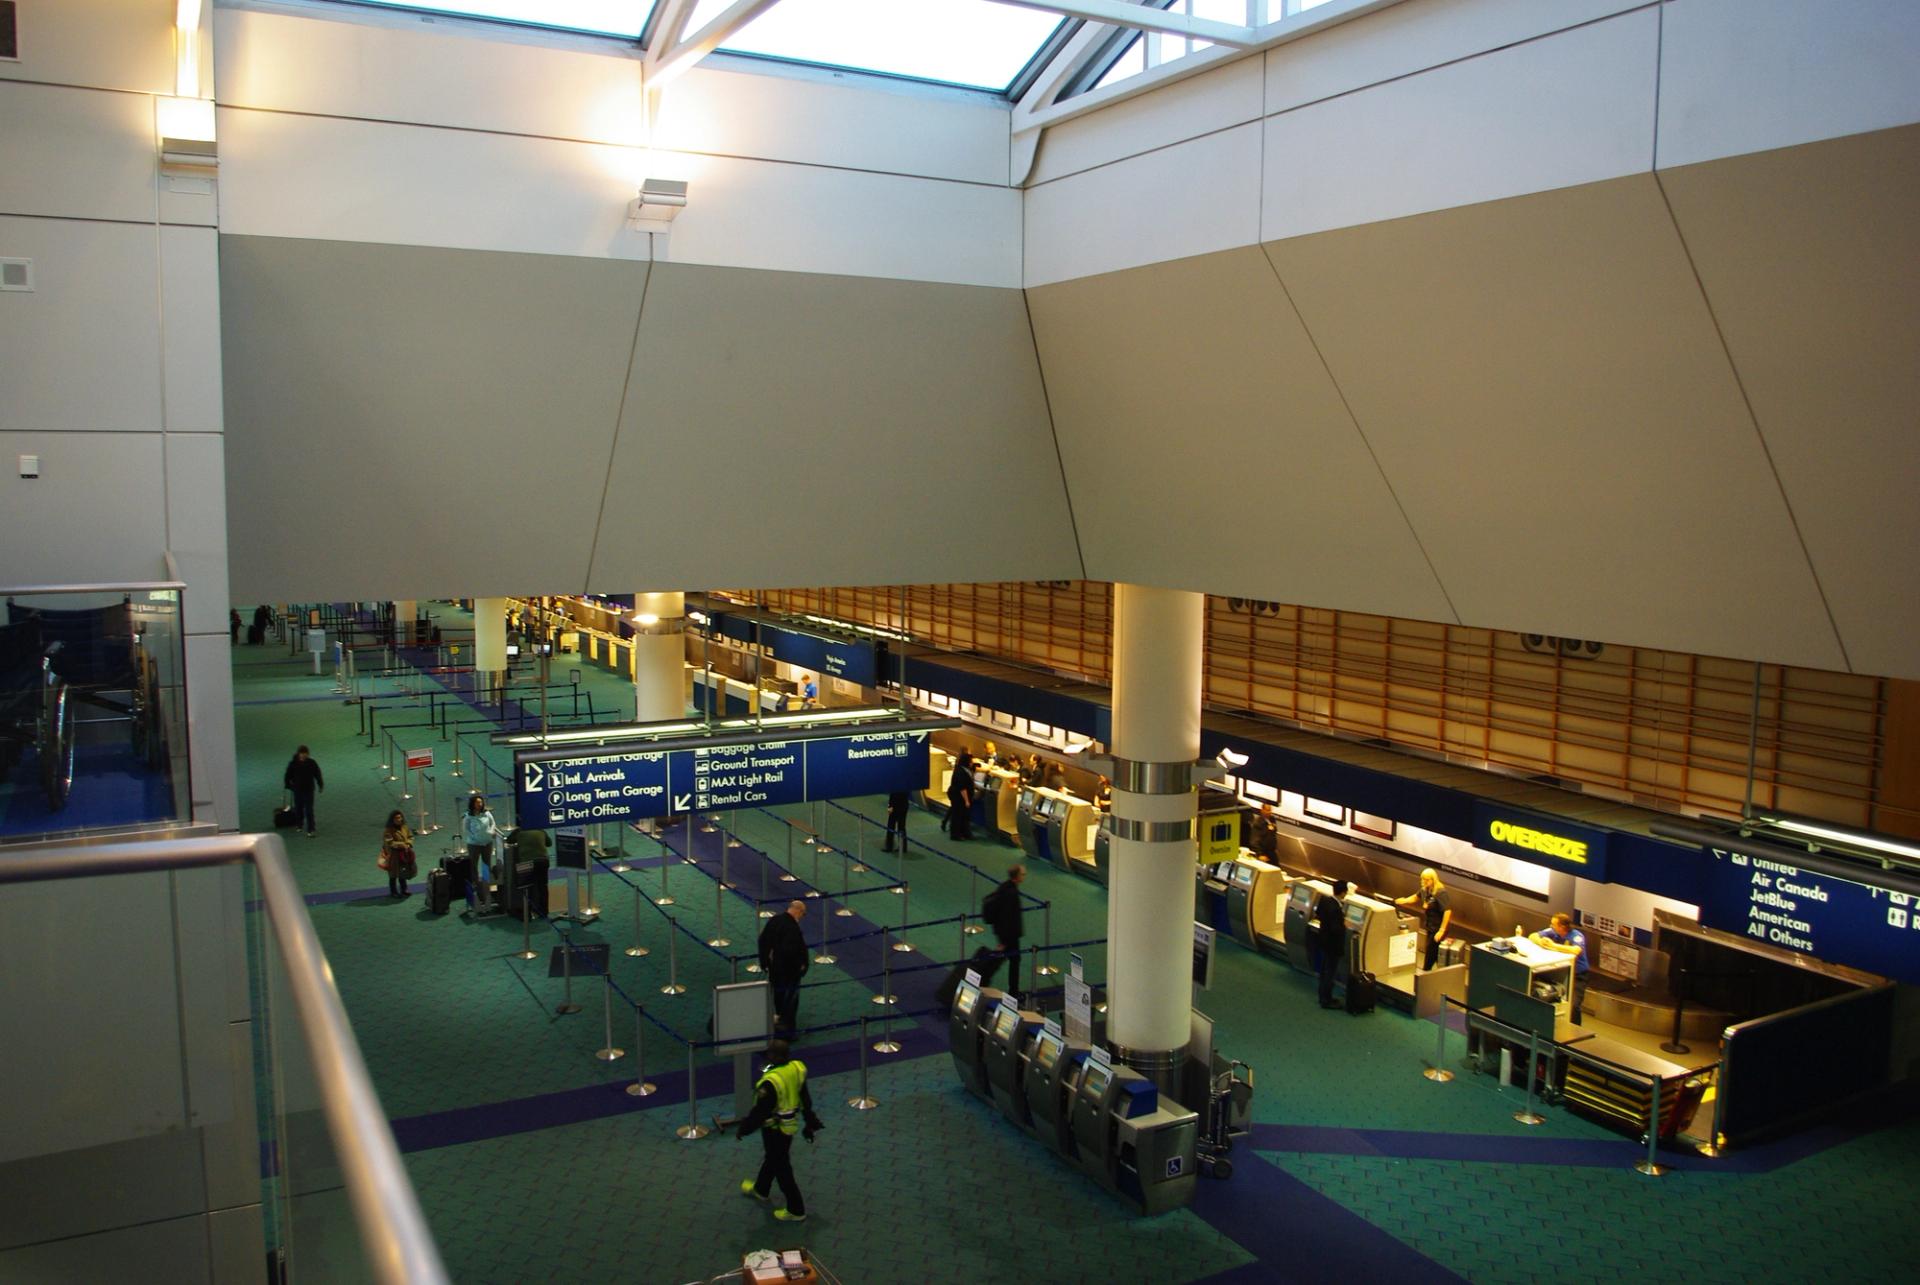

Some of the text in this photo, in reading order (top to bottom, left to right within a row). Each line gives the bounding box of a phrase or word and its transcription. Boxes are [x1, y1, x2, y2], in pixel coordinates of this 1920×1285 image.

[711, 741, 786, 755] Baggage Claim
[848, 748, 894, 759] Restrooms
[565, 752, 664, 767] Short Term Garage
[711, 755, 795, 771] Ground Transport
[565, 769, 625, 785] Intl. Arrivals
[711, 770, 783, 788] MAX Light Rail
[566, 791, 591, 803] Long
[594, 788, 620, 799] Term
[622, 785, 664, 797] Garage
[711, 791, 767, 805] Rental Cars
[568, 804, 631, 819] Port Offices
[1490, 820, 1587, 864] OVERSIZE
[1752, 858, 1797, 876] United
[1751, 872, 1828, 902] Air Canada
[1749, 889, 1796, 911] JetBlue
[1749, 905, 1810, 933] American
[1748, 922, 1813, 951] All Others
